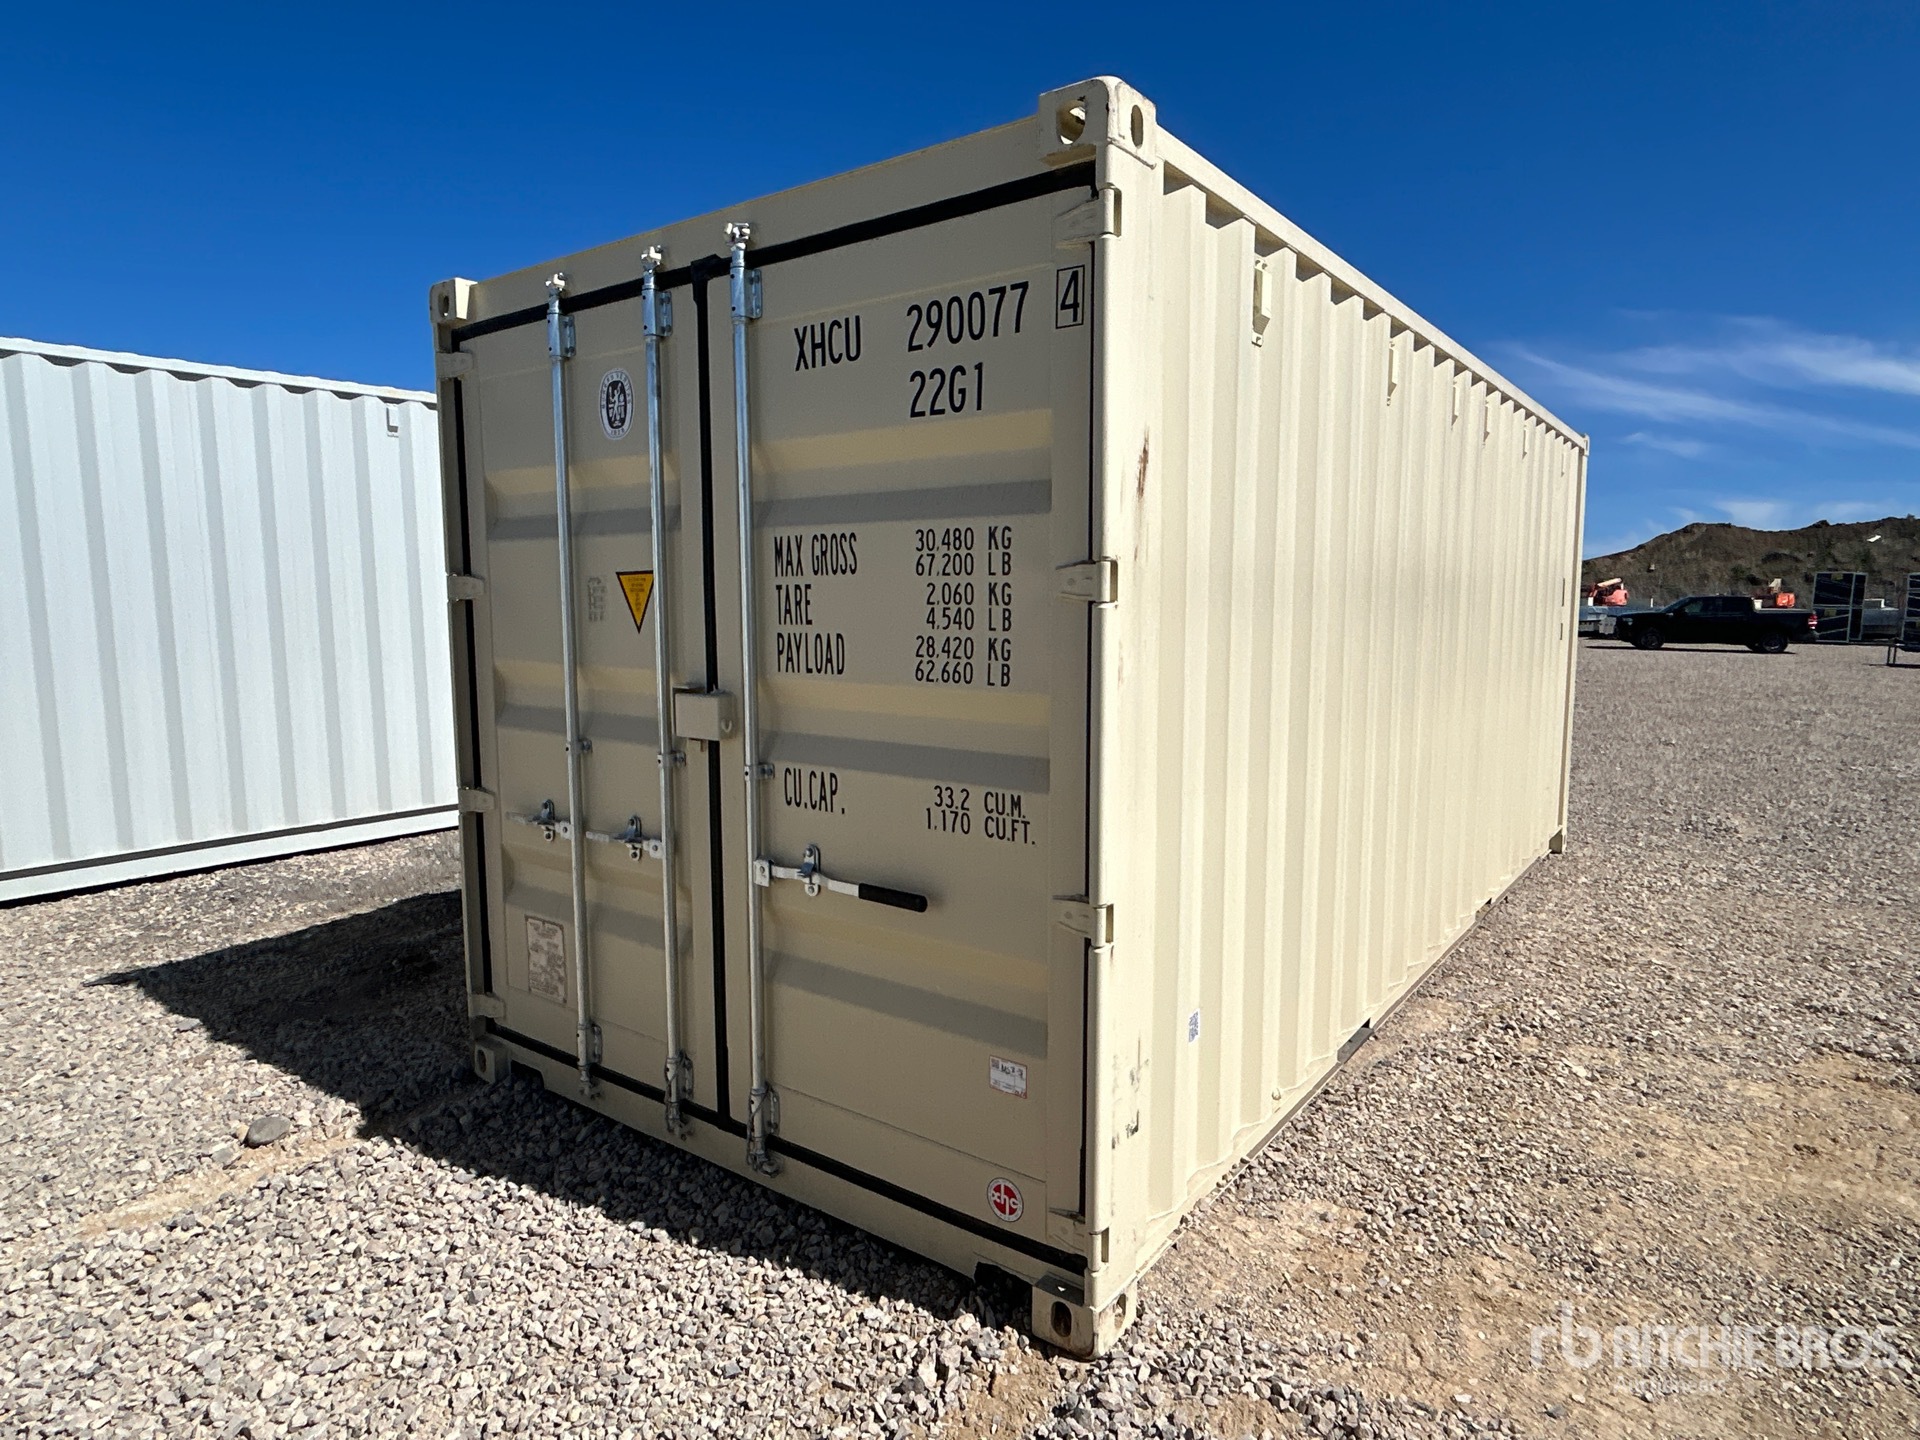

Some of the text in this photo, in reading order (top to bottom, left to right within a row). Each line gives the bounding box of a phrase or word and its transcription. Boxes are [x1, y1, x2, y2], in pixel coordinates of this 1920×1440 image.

[794, 270, 1080, 371] XHCU 290077 4
[910, 362, 983, 418] 22G1
[774, 535, 804, 577] MAX
[811, 532, 858, 576] GROSS
[988, 526, 1012, 550] KG
[988, 552, 1012, 576] LB
[775, 584, 813, 625] TARE
[988, 582, 1012, 606] KG
[988, 607, 1012, 632] LB
[777, 632, 845, 675] PAYLOAD
[987, 637, 1012, 661] KG
[987, 662, 1011, 687] LB
[933, 785, 971, 812] 33.2
[984, 791, 1027, 819] CU.M.
[984, 816, 1037, 846] CU.FT.
